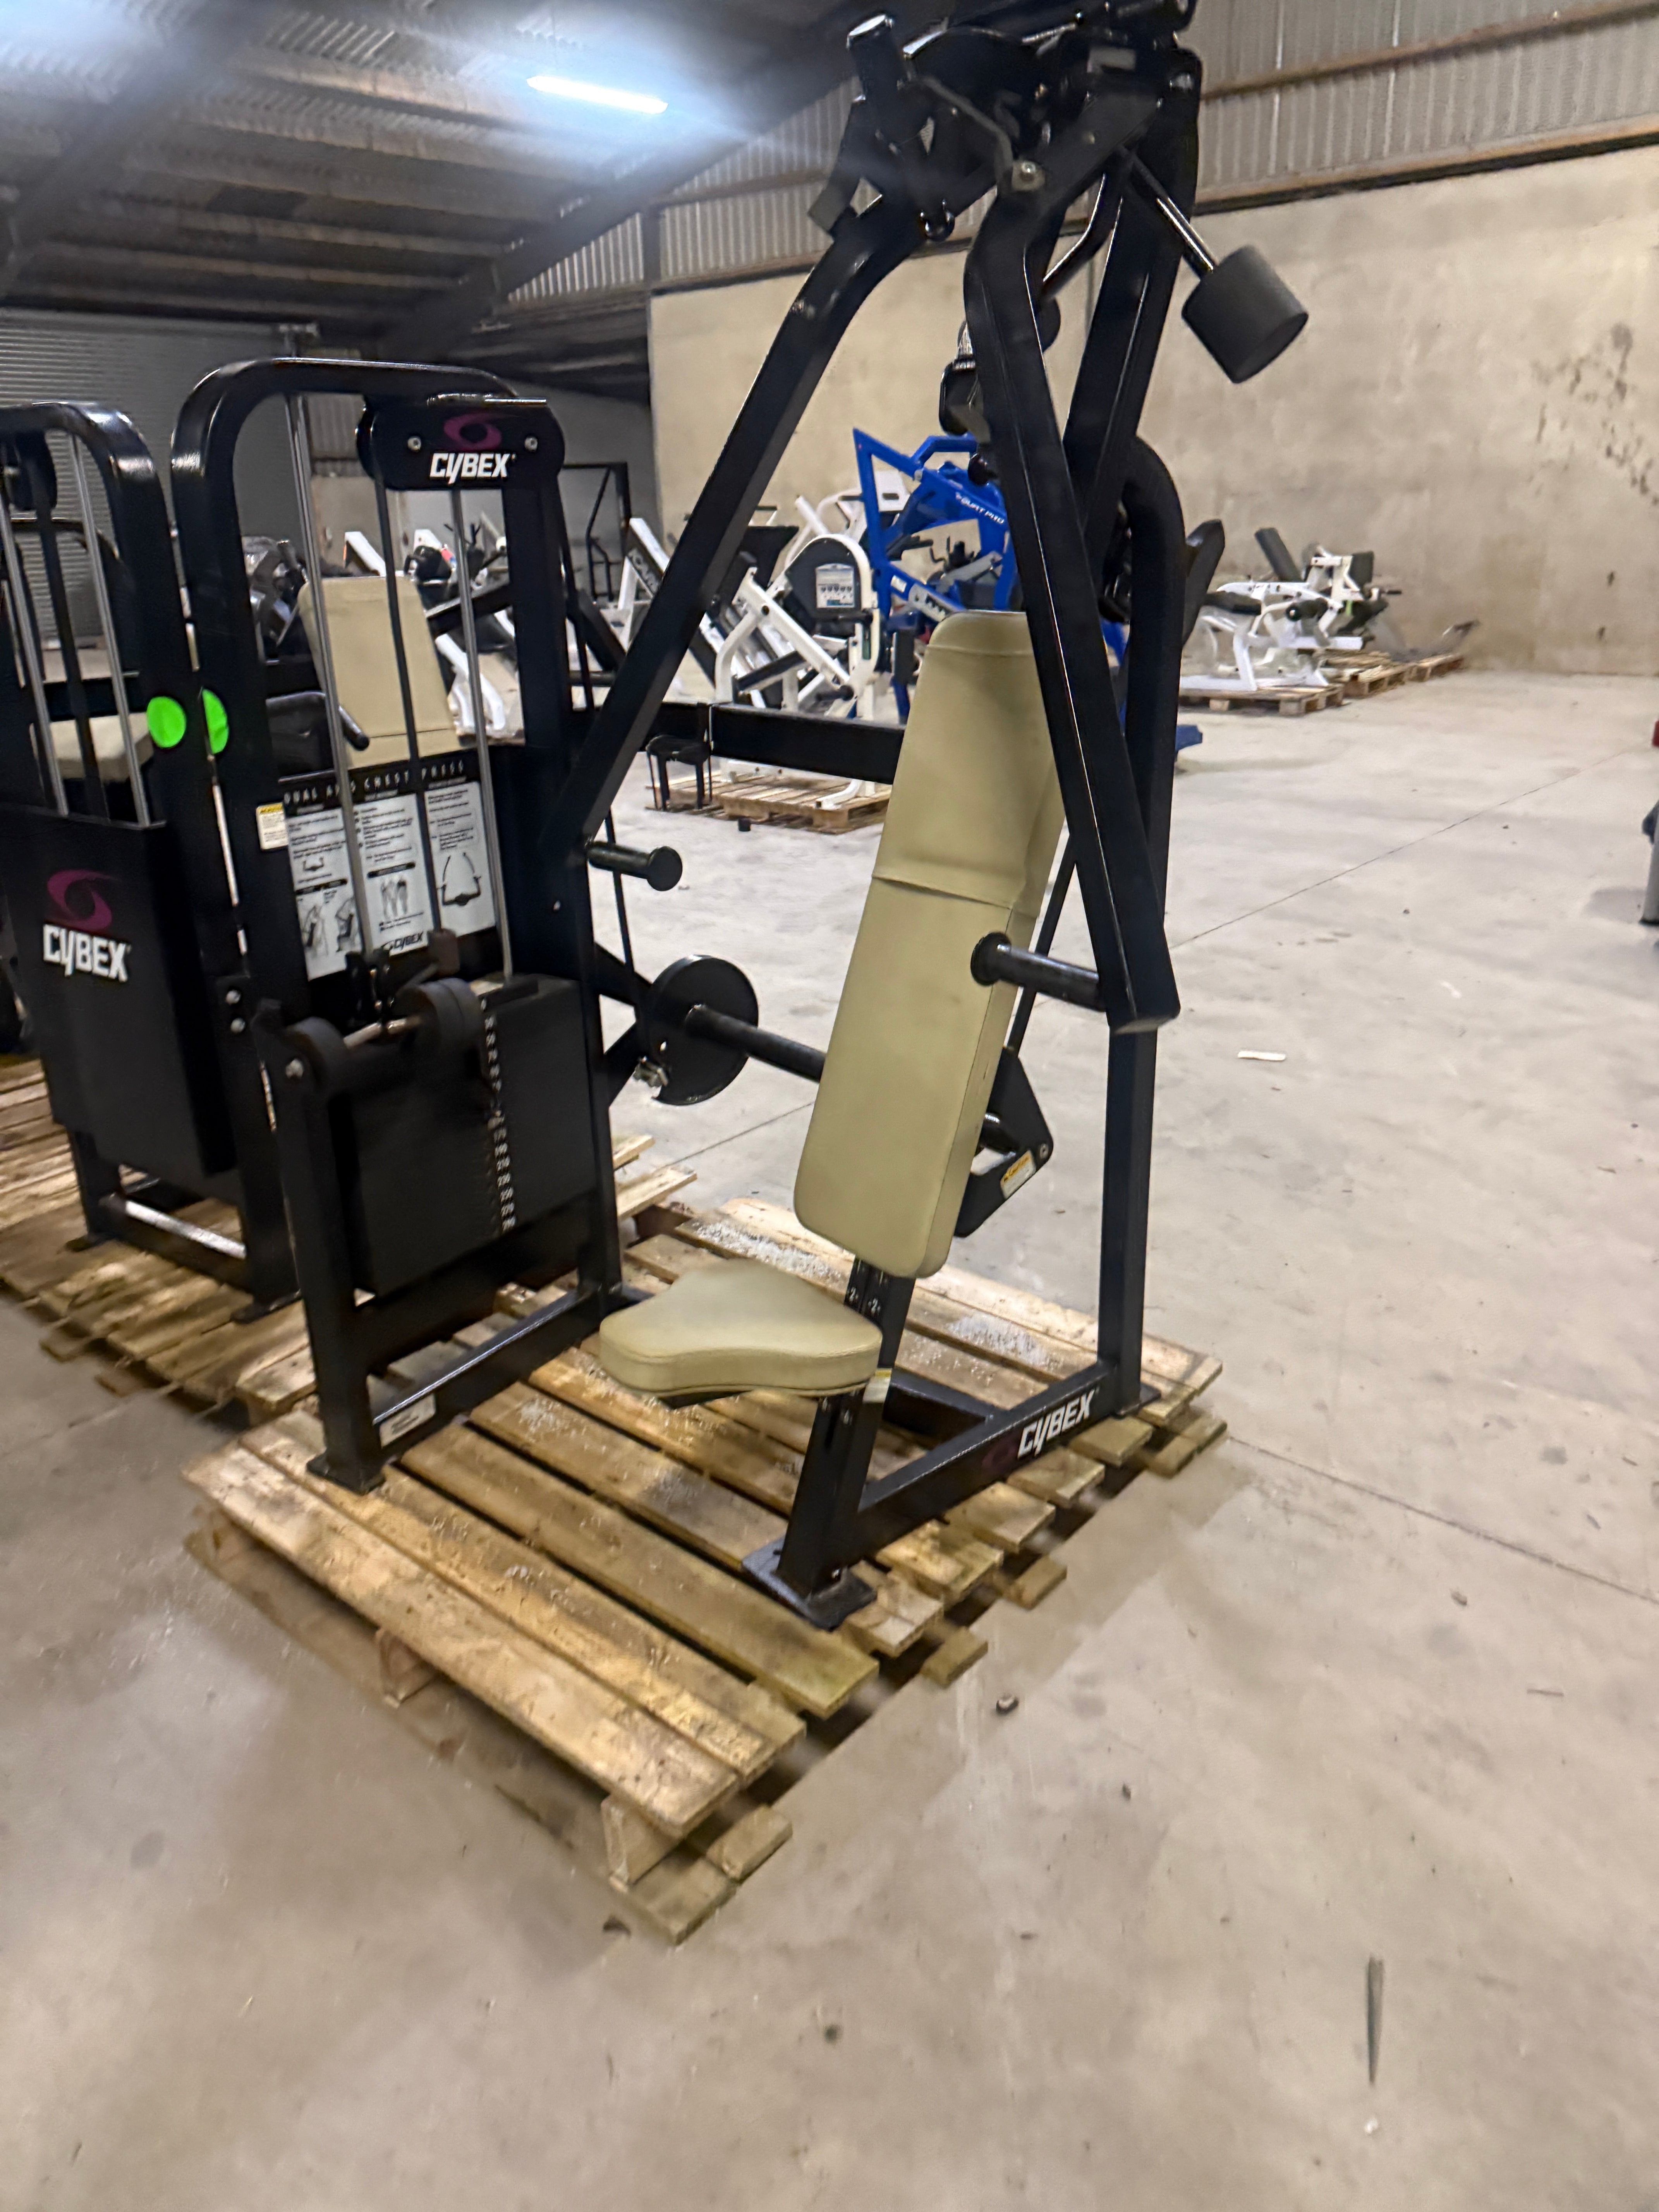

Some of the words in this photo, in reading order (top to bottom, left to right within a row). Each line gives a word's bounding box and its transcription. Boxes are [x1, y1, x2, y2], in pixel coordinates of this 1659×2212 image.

[429, 453, 510, 484] CYBEX
[43, 924, 128, 982] CYBEX
[1018, 1389, 1094, 1459] CYBEX
